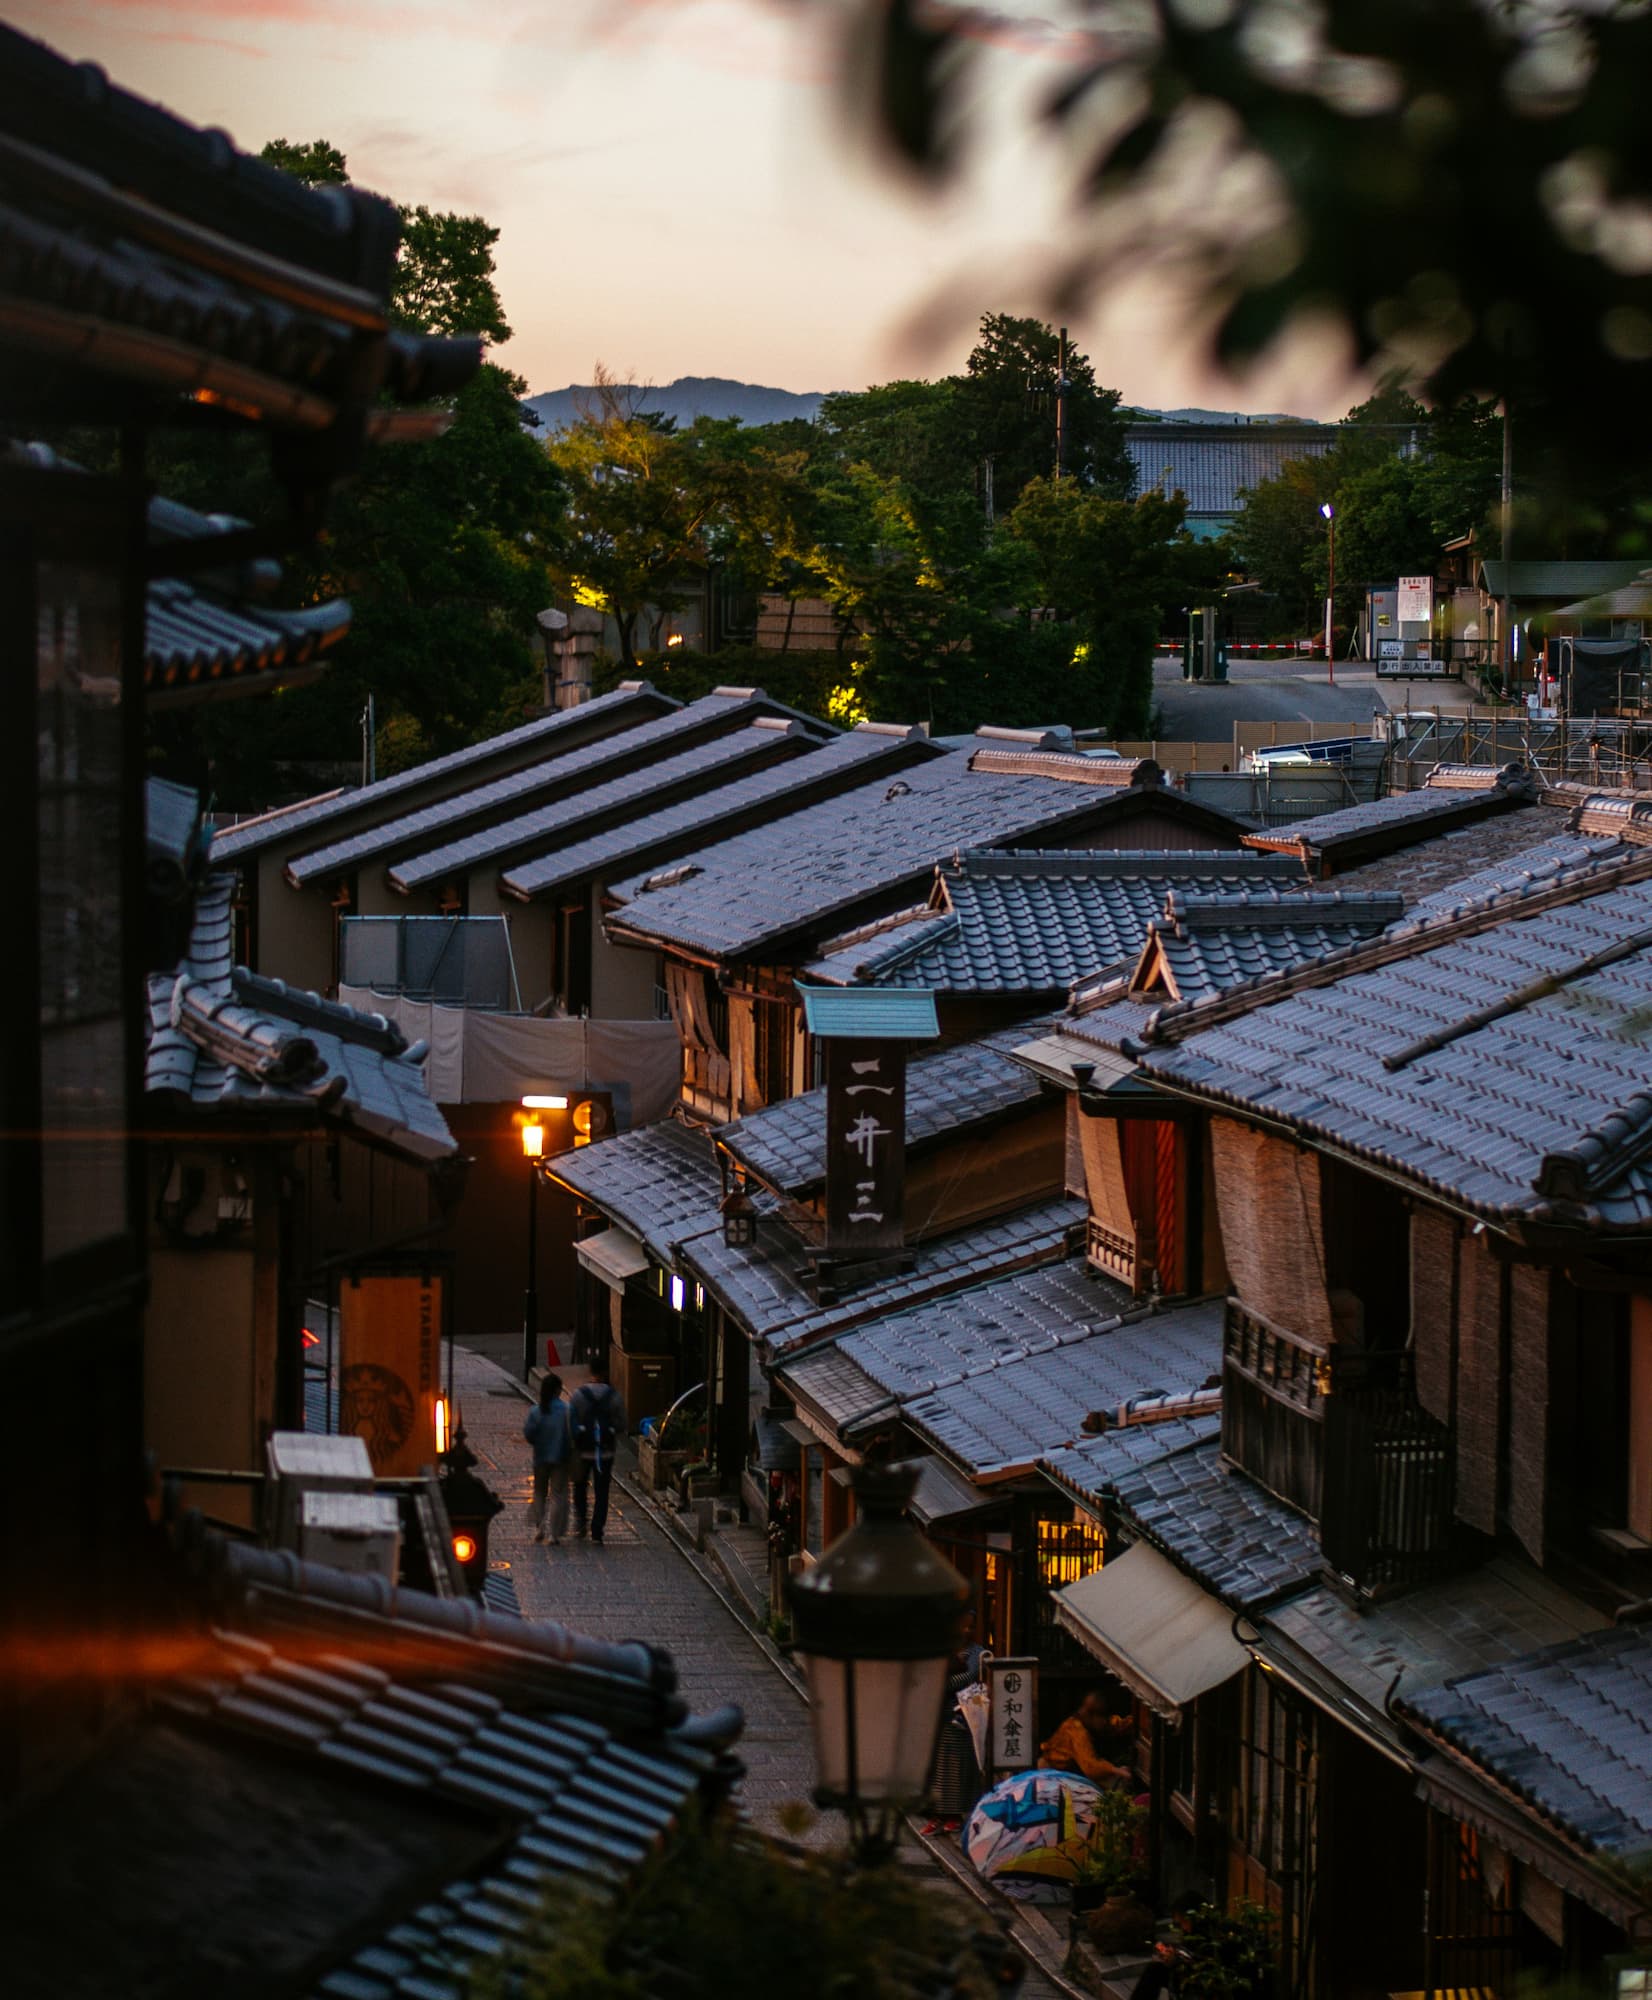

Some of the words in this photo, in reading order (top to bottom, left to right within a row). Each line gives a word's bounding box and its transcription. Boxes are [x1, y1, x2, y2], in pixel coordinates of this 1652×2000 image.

[845, 1057, 895, 1224] 二井三
[1003, 1698, 1023, 1757] 和傘屋
